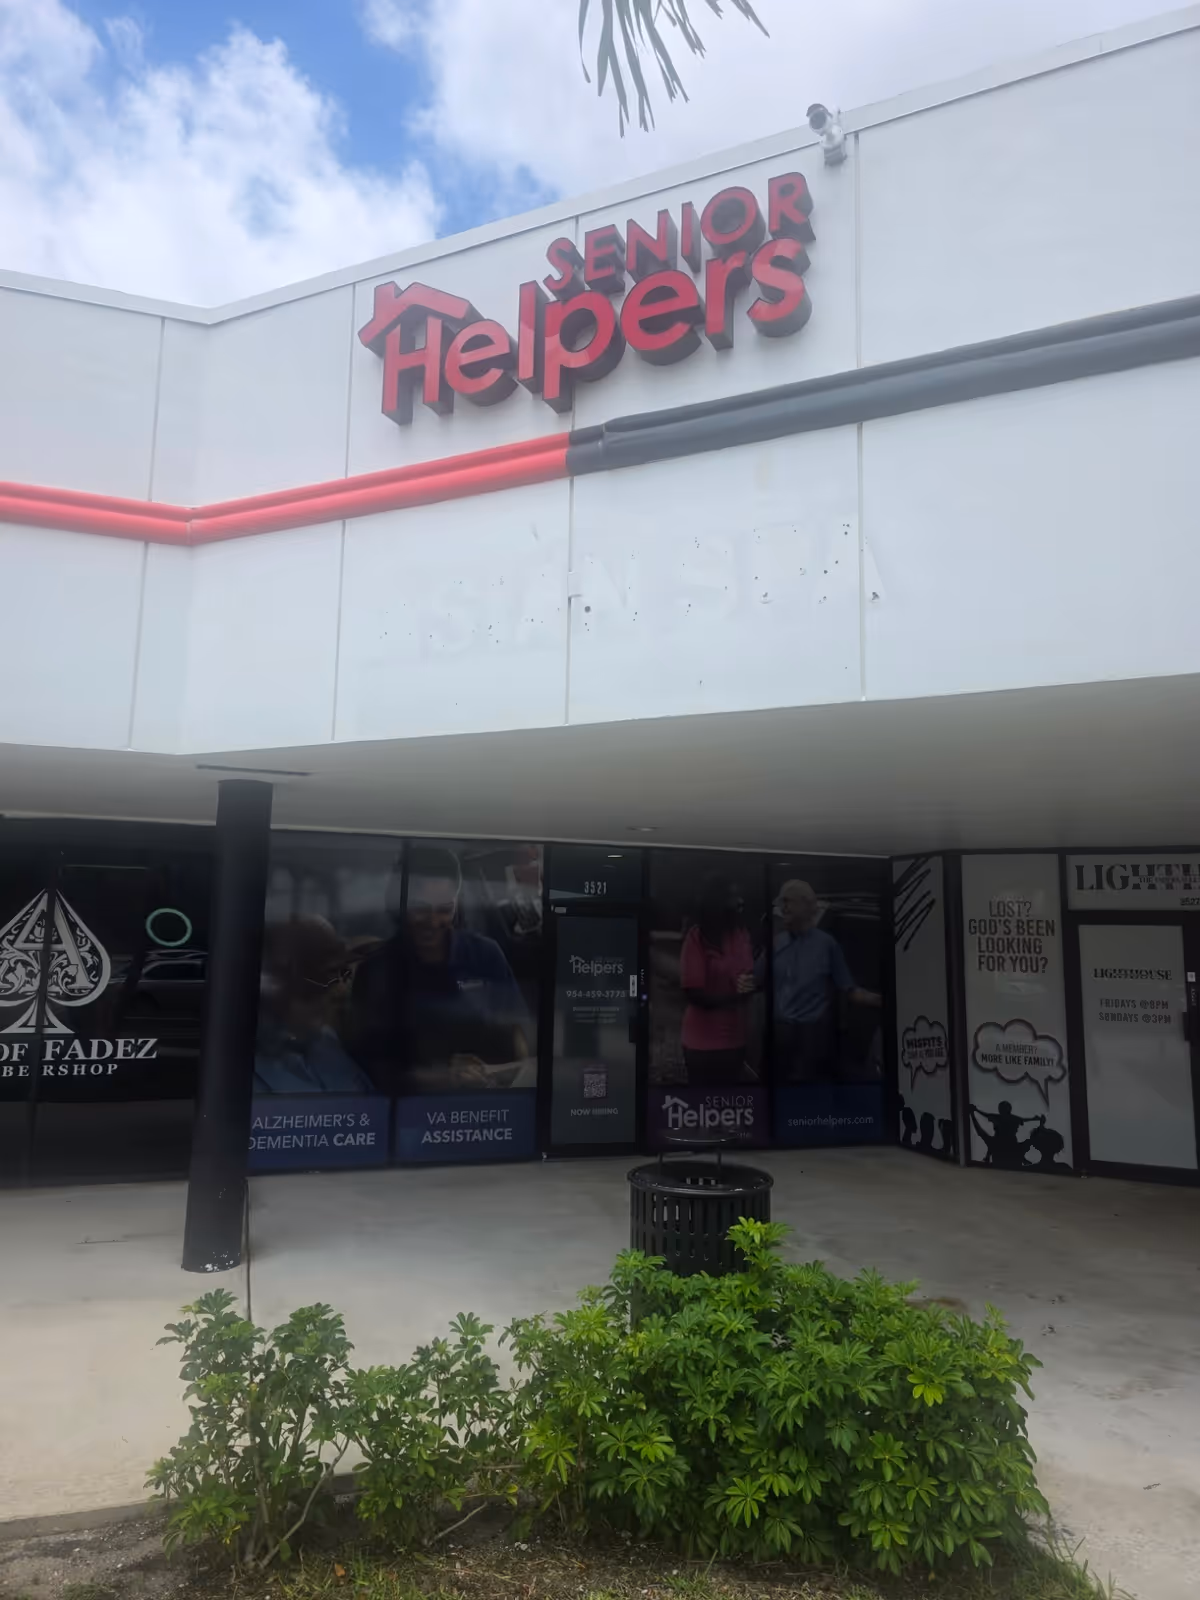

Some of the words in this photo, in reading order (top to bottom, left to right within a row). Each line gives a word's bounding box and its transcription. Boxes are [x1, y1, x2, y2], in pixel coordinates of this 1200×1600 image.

[543, 172, 812, 292] SENIOR
[360, 237, 811, 420] Helpers
[585, 881, 607, 895] 3521
[989, 900, 1031, 917] LOST?
[969, 918, 1011, 935] GOD'S
[1016, 919, 1055, 936] BEEN
[977, 936, 1042, 954] LOOKING
[569, 955, 624, 976] Helpers
[978, 955, 1006, 971] FOR
[1010, 956, 1049, 973] YOU?
[1099, 998, 1136, 1009] FRIDAYS
[41, 1038, 158, 1061] FADEZ
[981, 1053, 1003, 1064] MORE
[1005, 1055, 1022, 1065] LIKE
[705, 1095, 753, 1107] SENIOR
[427, 1111, 446, 1125] VA
[450, 1109, 510, 1124] BENEFIT
[662, 1095, 754, 1128] Helpers
[252, 1114, 355, 1130] ALZHEIMER'S
[359, 1114, 370, 1126] &
[788, 1115, 874, 1128] seniorhelpers.com
[248, 1134, 330, 1151] DEMENTIA
[333, 1133, 376, 1146] CARE
[422, 1128, 513, 1144] ASSISTANCE
